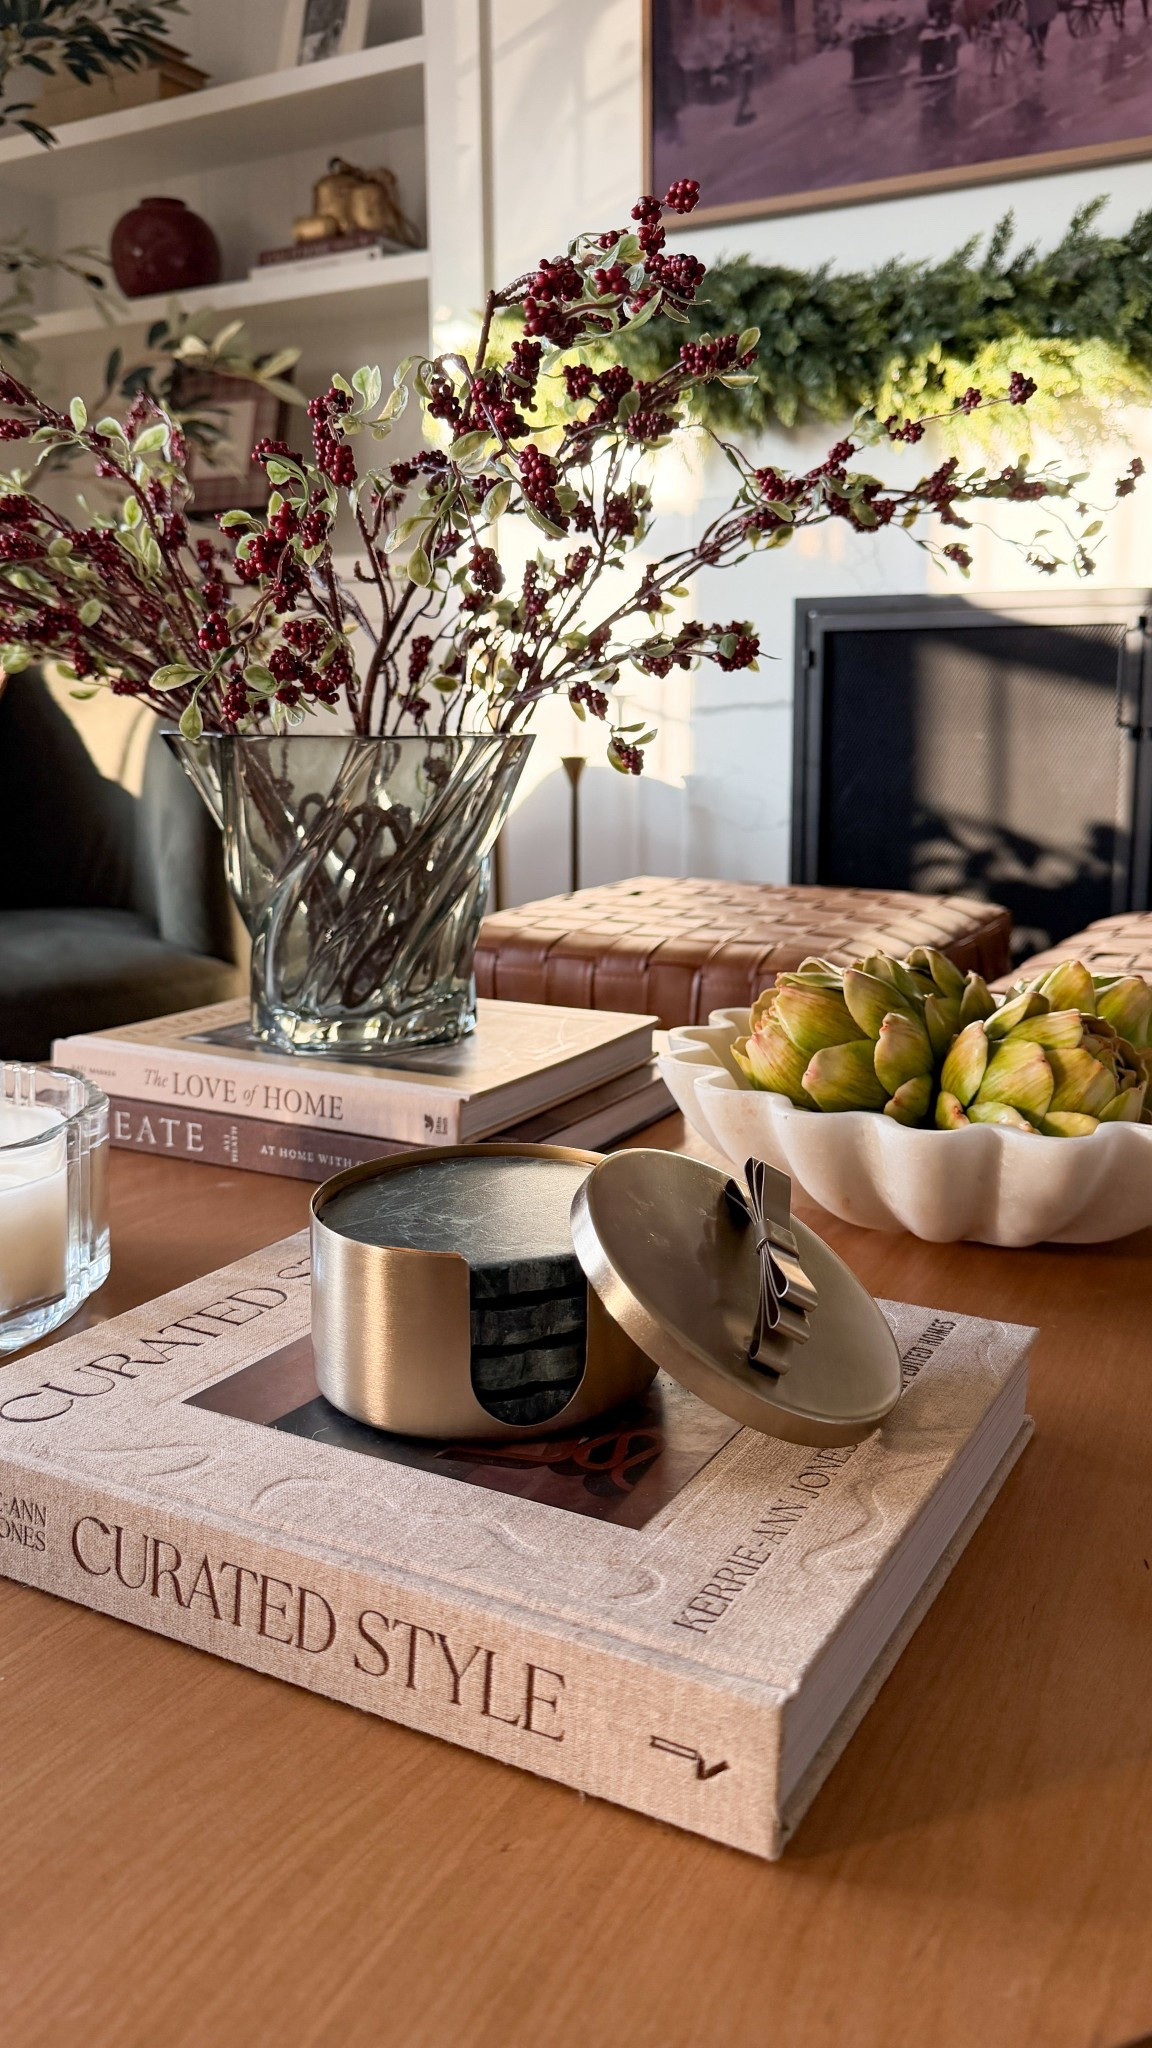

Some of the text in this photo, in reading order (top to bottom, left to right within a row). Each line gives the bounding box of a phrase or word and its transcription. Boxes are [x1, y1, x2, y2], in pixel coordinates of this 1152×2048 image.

[144, 1068, 344, 1121] The LOVE of HOME
[114, 1110, 204, 1152] EATE
[260, 1144, 275, 1157] AT
[279, 1147, 314, 1162] HOME
[317, 1153, 351, 1167] WITH
[0, 1287, 288, 1423] CURATED
[917, 1318, 957, 1347] HOMES
[0, 1517, 46, 1552] ONES
[672, 1497, 809, 1635] KERRIE-ANN
[72, 1516, 567, 1742] CURATED STYLE
